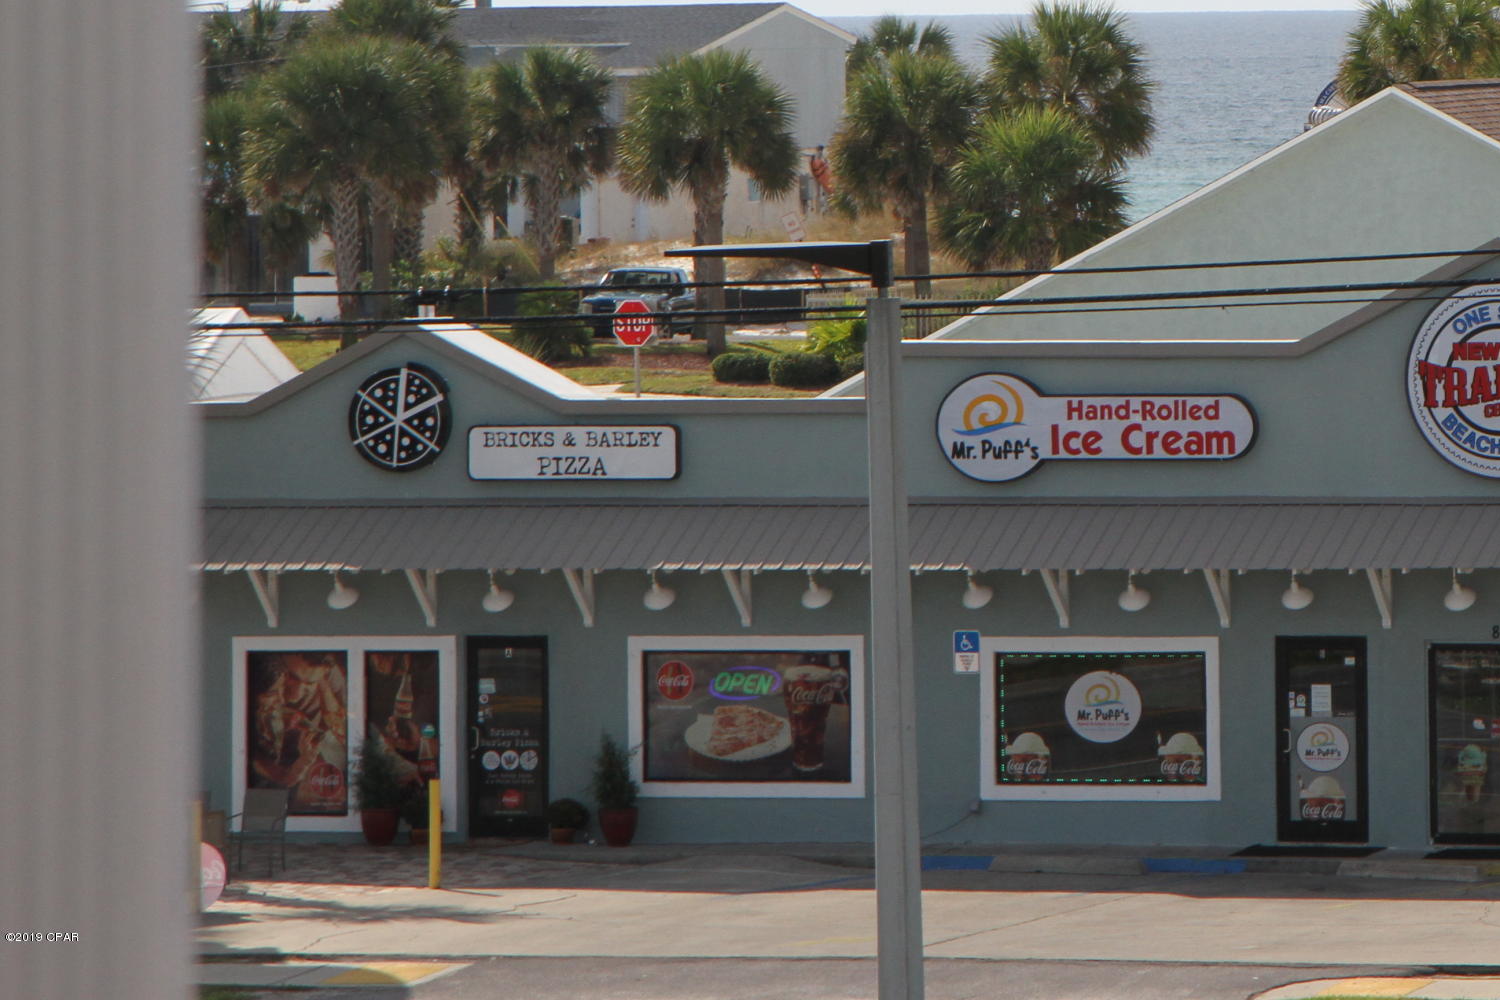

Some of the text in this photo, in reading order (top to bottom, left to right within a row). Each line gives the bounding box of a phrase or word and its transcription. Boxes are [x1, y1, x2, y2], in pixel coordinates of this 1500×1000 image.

[616, 315, 650, 332] STOP
[1452, 306, 1492, 334] ONE
[1066, 399, 1221, 421] Hand-Rolled
[483, 431, 663, 448] BRICKS & BARLEY
[951, 437, 1040, 460] Mr. Puff's
[1050, 423, 1237, 456] Ice Cream
[537, 456, 608, 476] PIZZA
[715, 671, 775, 695] OPEN
[1077, 709, 1093, 721] Mr.
